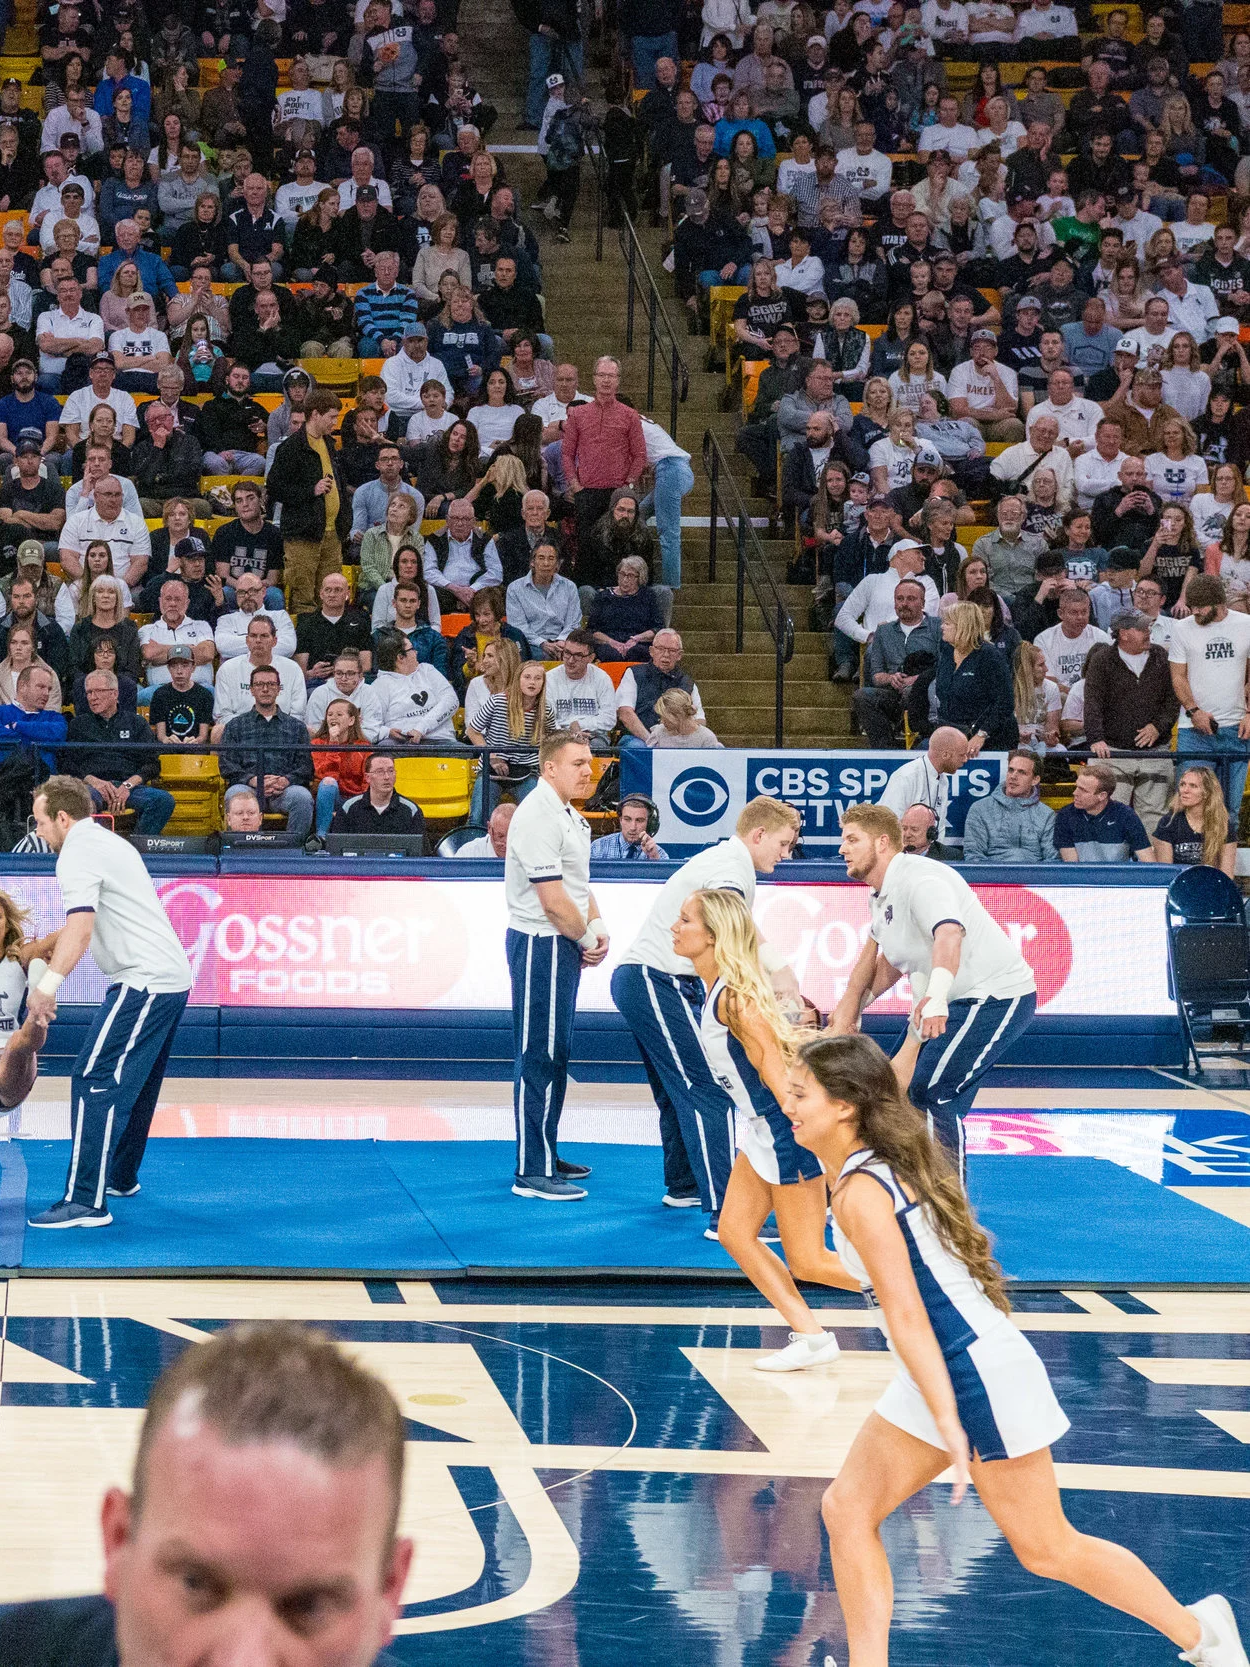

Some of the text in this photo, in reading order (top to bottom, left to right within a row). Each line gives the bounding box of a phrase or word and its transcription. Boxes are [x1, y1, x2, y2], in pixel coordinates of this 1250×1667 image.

[230, 555, 267, 571] STATE
[1205, 650, 1235, 660] STATE
[1206, 642, 1233, 652] UTAH
[755, 767, 992, 797] CBS SPTS
[230, 969, 390, 994] FOODS
